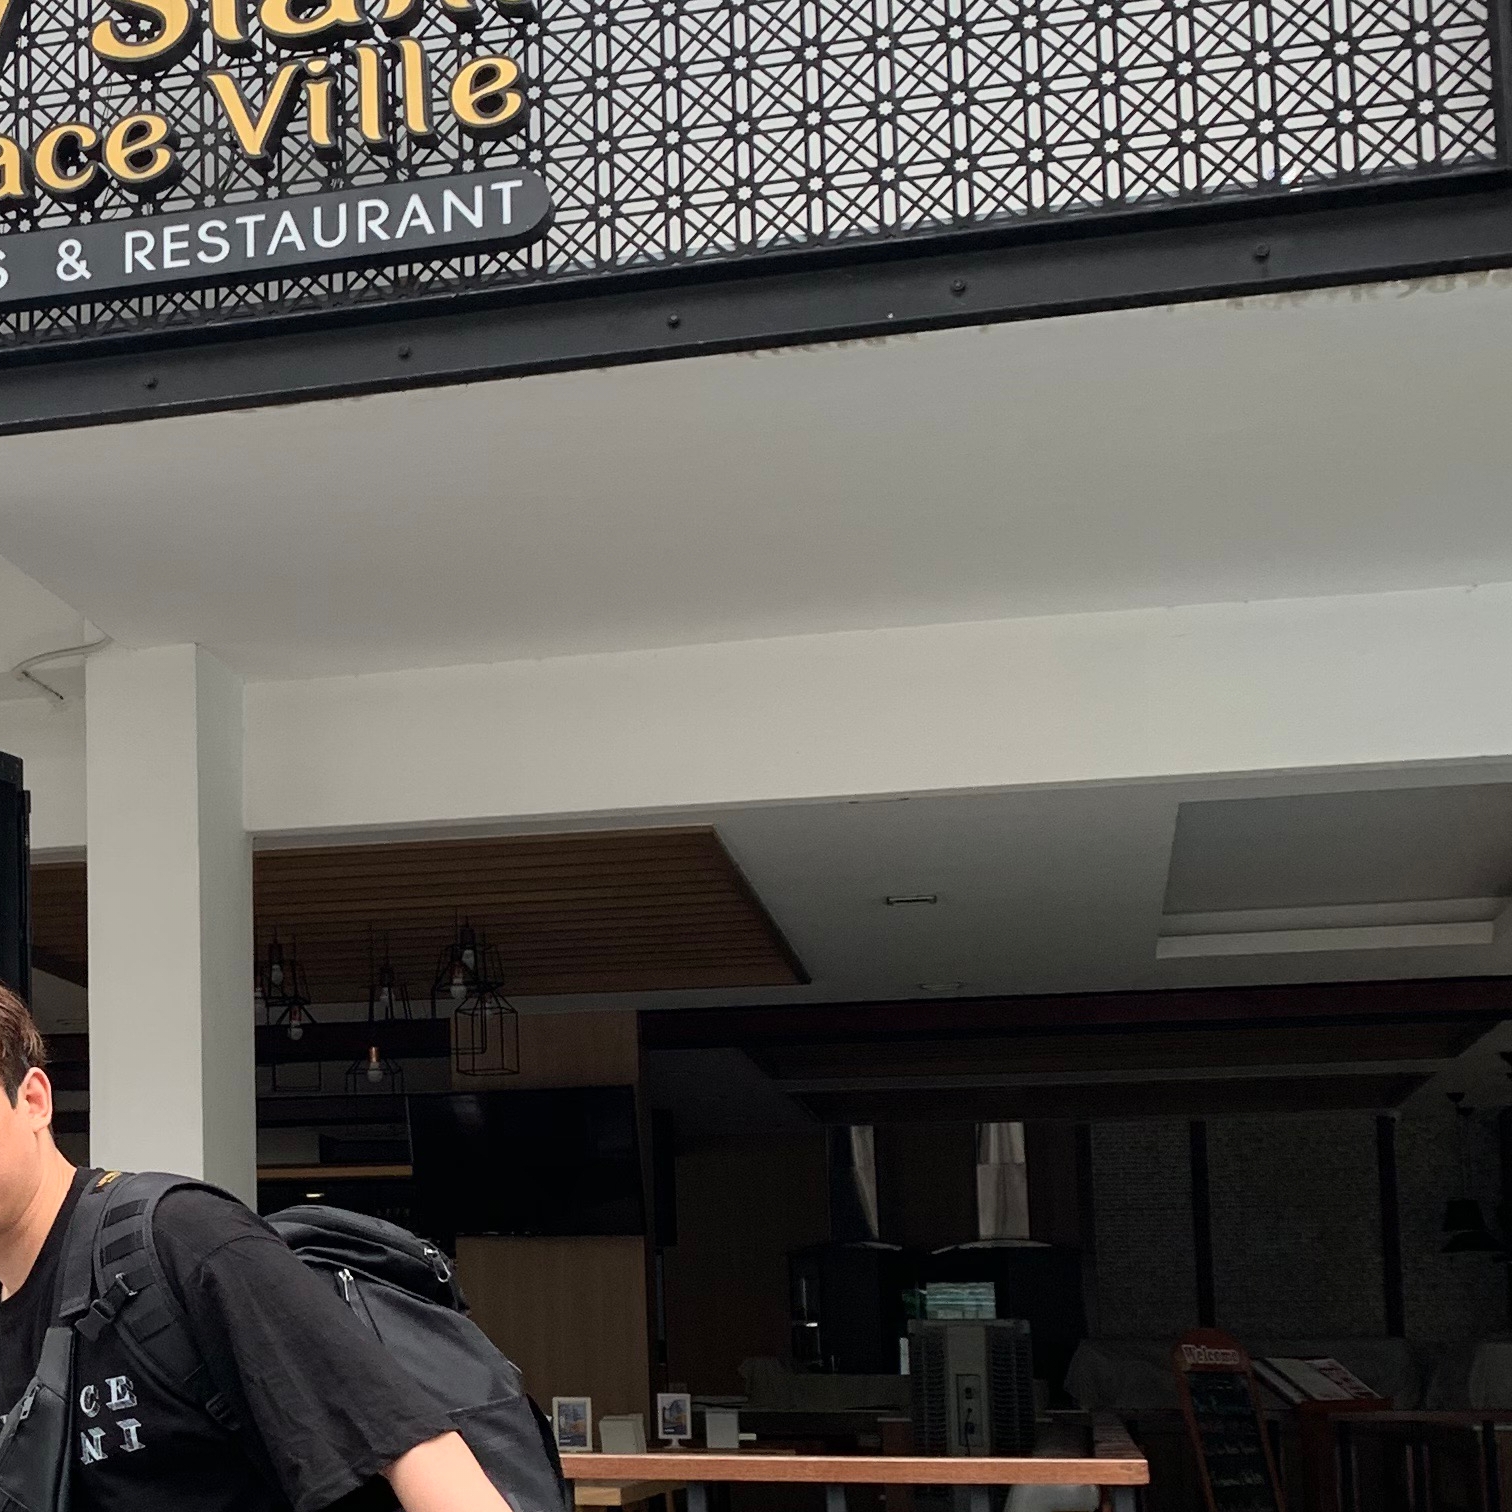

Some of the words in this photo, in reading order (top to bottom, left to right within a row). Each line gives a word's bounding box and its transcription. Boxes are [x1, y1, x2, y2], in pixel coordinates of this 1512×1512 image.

[205, 37, 524, 157] Ville
[55, 238, 92, 283] &
[123, 179, 524, 274] RESTAURANT
